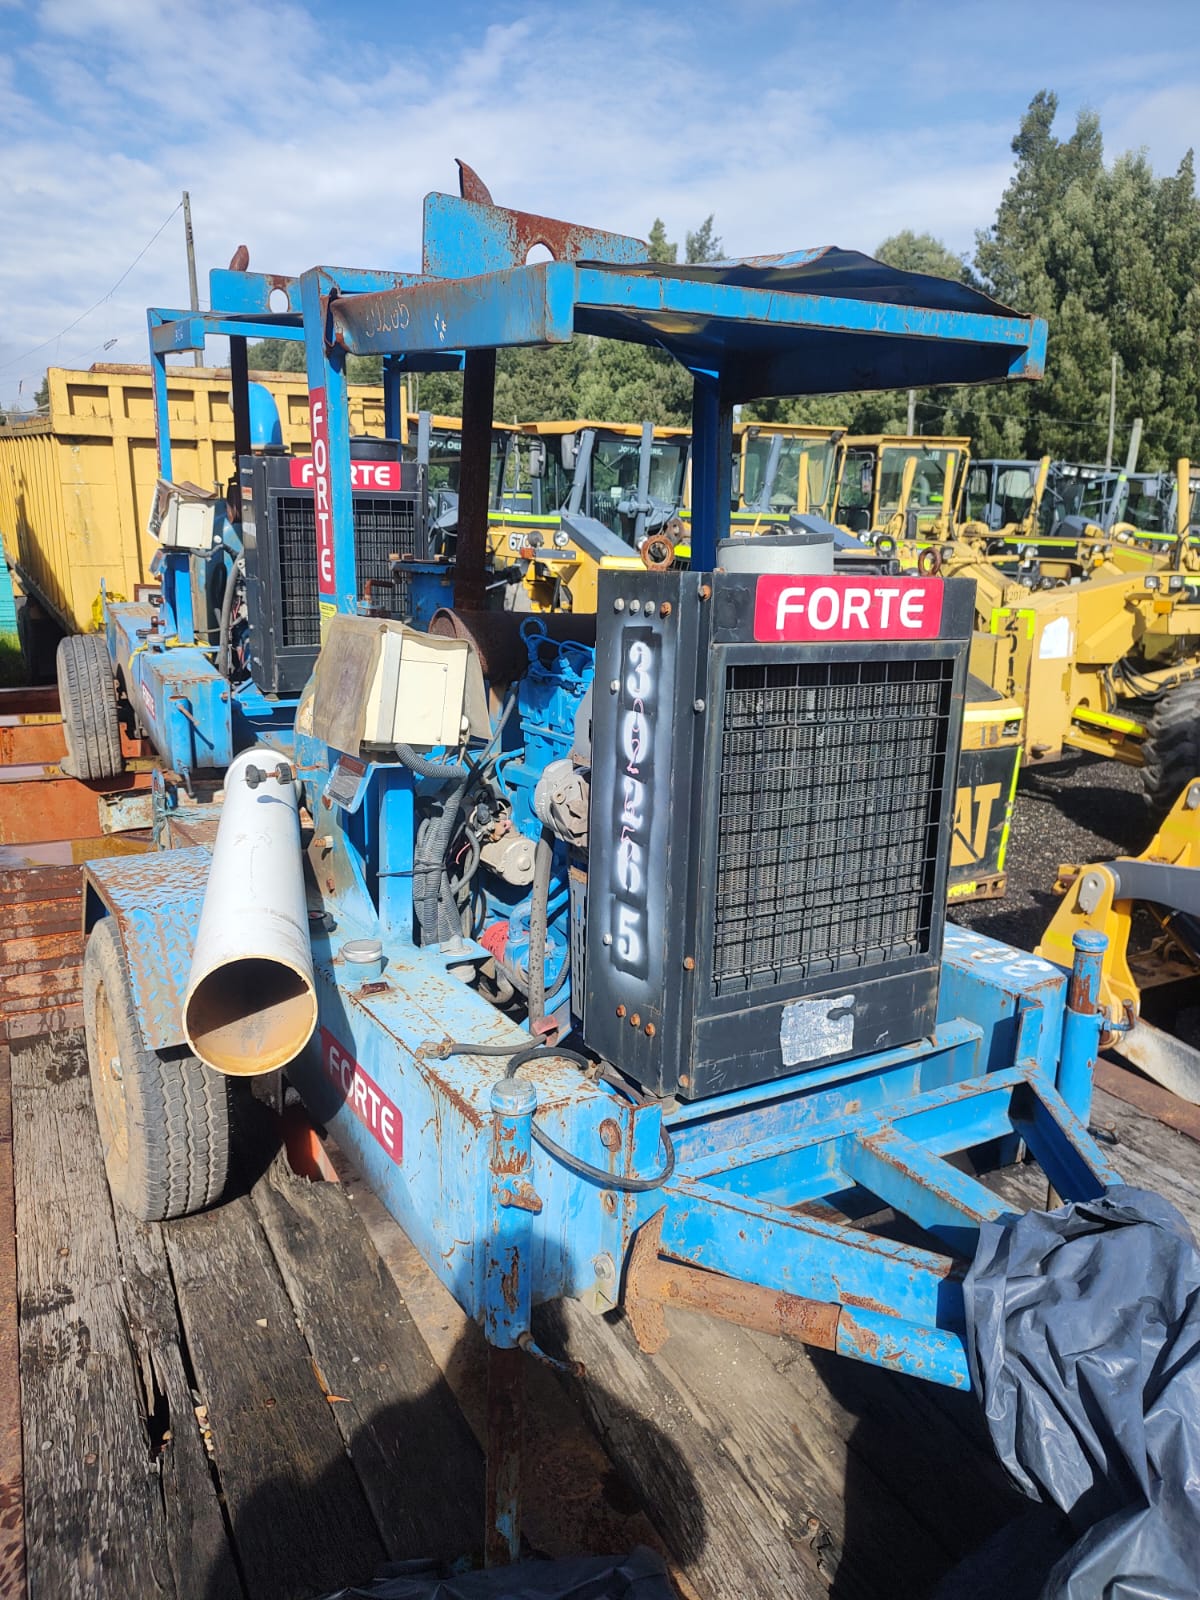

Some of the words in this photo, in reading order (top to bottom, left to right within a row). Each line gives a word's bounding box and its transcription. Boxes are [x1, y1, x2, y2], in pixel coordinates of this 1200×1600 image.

[302, 464, 391, 487] FTE
[312, 402, 332, 582] FORTE
[776, 587, 926, 631] FORTE
[616, 641, 652, 962] 30265
[950, 783, 1002, 867] AT
[329, 1046, 394, 1150] FORTE
